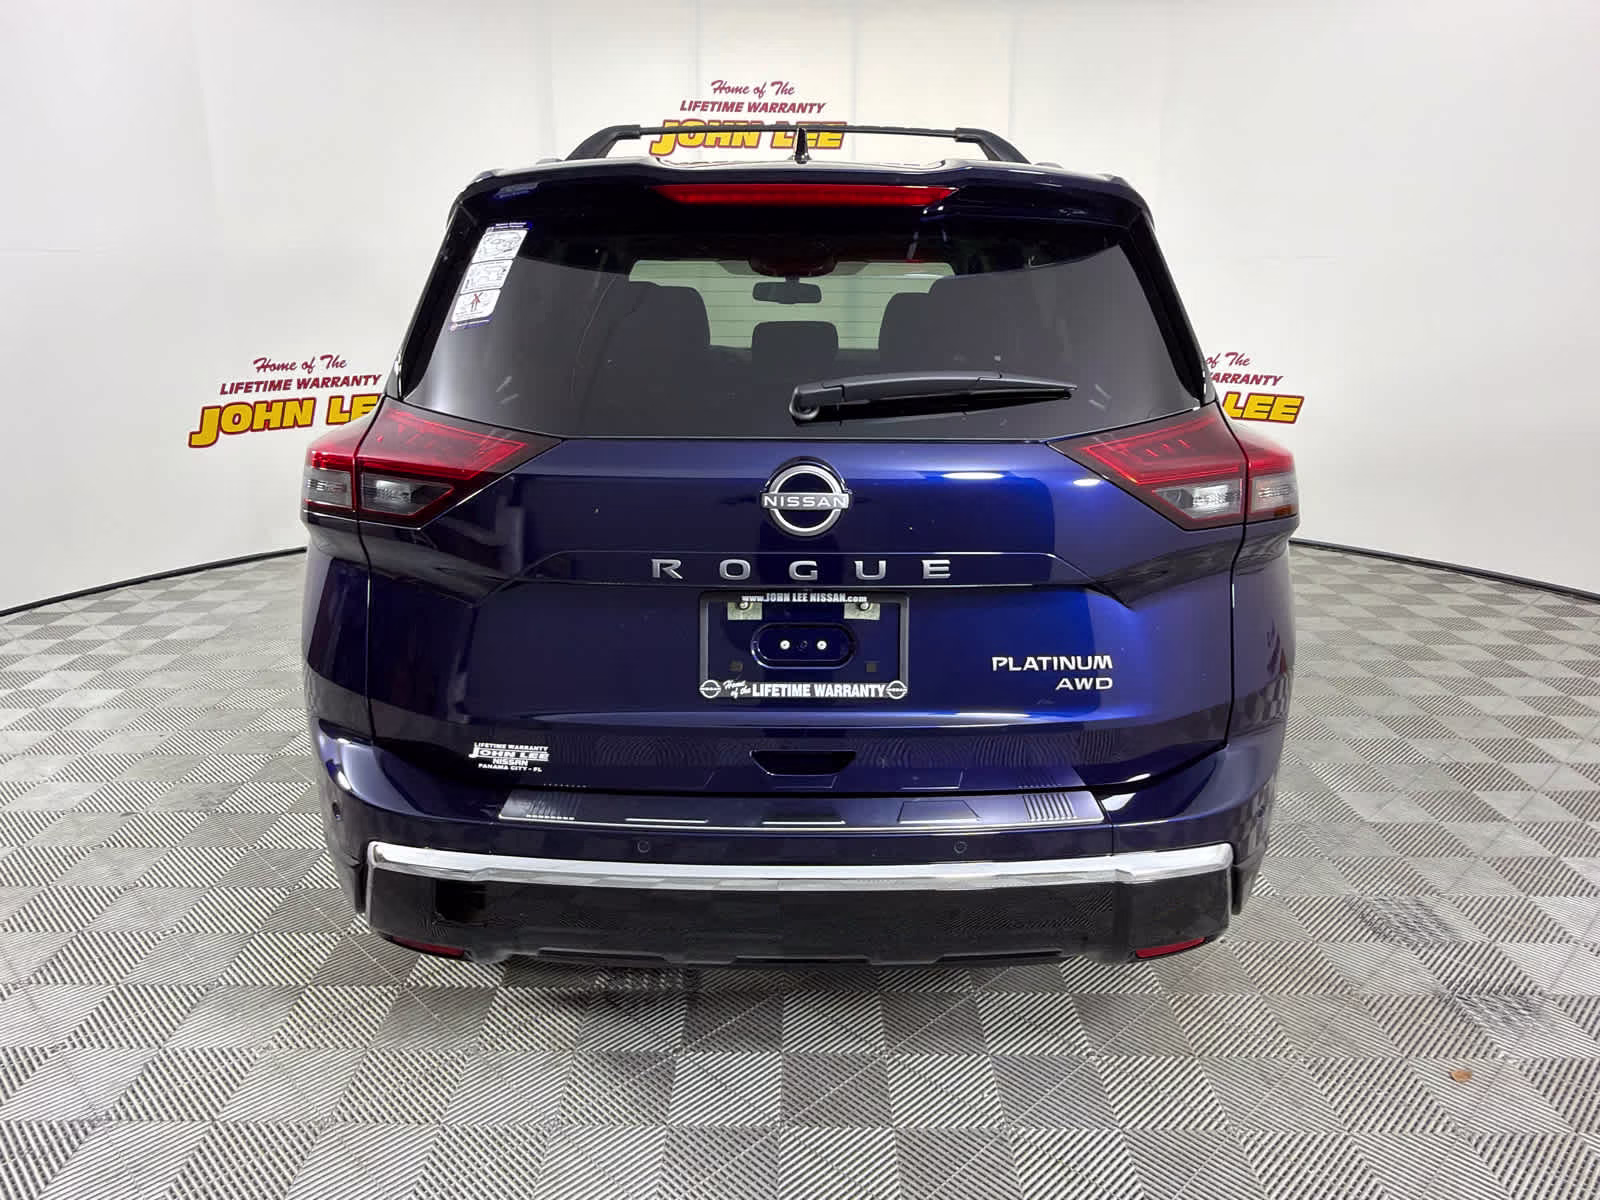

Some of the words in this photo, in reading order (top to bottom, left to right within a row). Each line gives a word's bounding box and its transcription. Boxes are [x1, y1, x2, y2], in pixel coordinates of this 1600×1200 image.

[711, 80, 749, 94] Home
[753, 82, 767, 98] of
[770, 81, 795, 95] The
[680, 100, 744, 113] LIFETIME
[747, 102, 826, 114] WARRANTY
[649, 119, 763, 156] JOHN
[253, 357, 297, 373] Home
[301, 356, 316, 374] of
[320, 354, 347, 369] The
[1206, 354, 1219, 368] of
[1225, 352, 1250, 366] The
[219, 379, 292, 395] LIFETIME
[296, 374, 382, 390] WARRANTY
[1210, 372, 1283, 385] ARRANTY
[1222, 391, 1305, 424] LEE
[188, 397, 317, 448] JOHN
[763, 495, 848, 507] NISSAN
[650, 558, 952, 581] ROGUE
[792, 592, 809, 603] LEE
[809, 592, 868, 603] NISSAN.com
[991, 655, 1113, 672] PLATINUM
[752, 683, 811, 698] LIFETIME
[813, 683, 886, 698] WARRANTY
[1055, 677, 1113, 691] AWD
[474, 742, 507, 750] LIFETIME
[468, 747, 516, 758] JOHN
[519, 751, 549, 761] LEE
[492, 758, 529, 766] NISSAN
